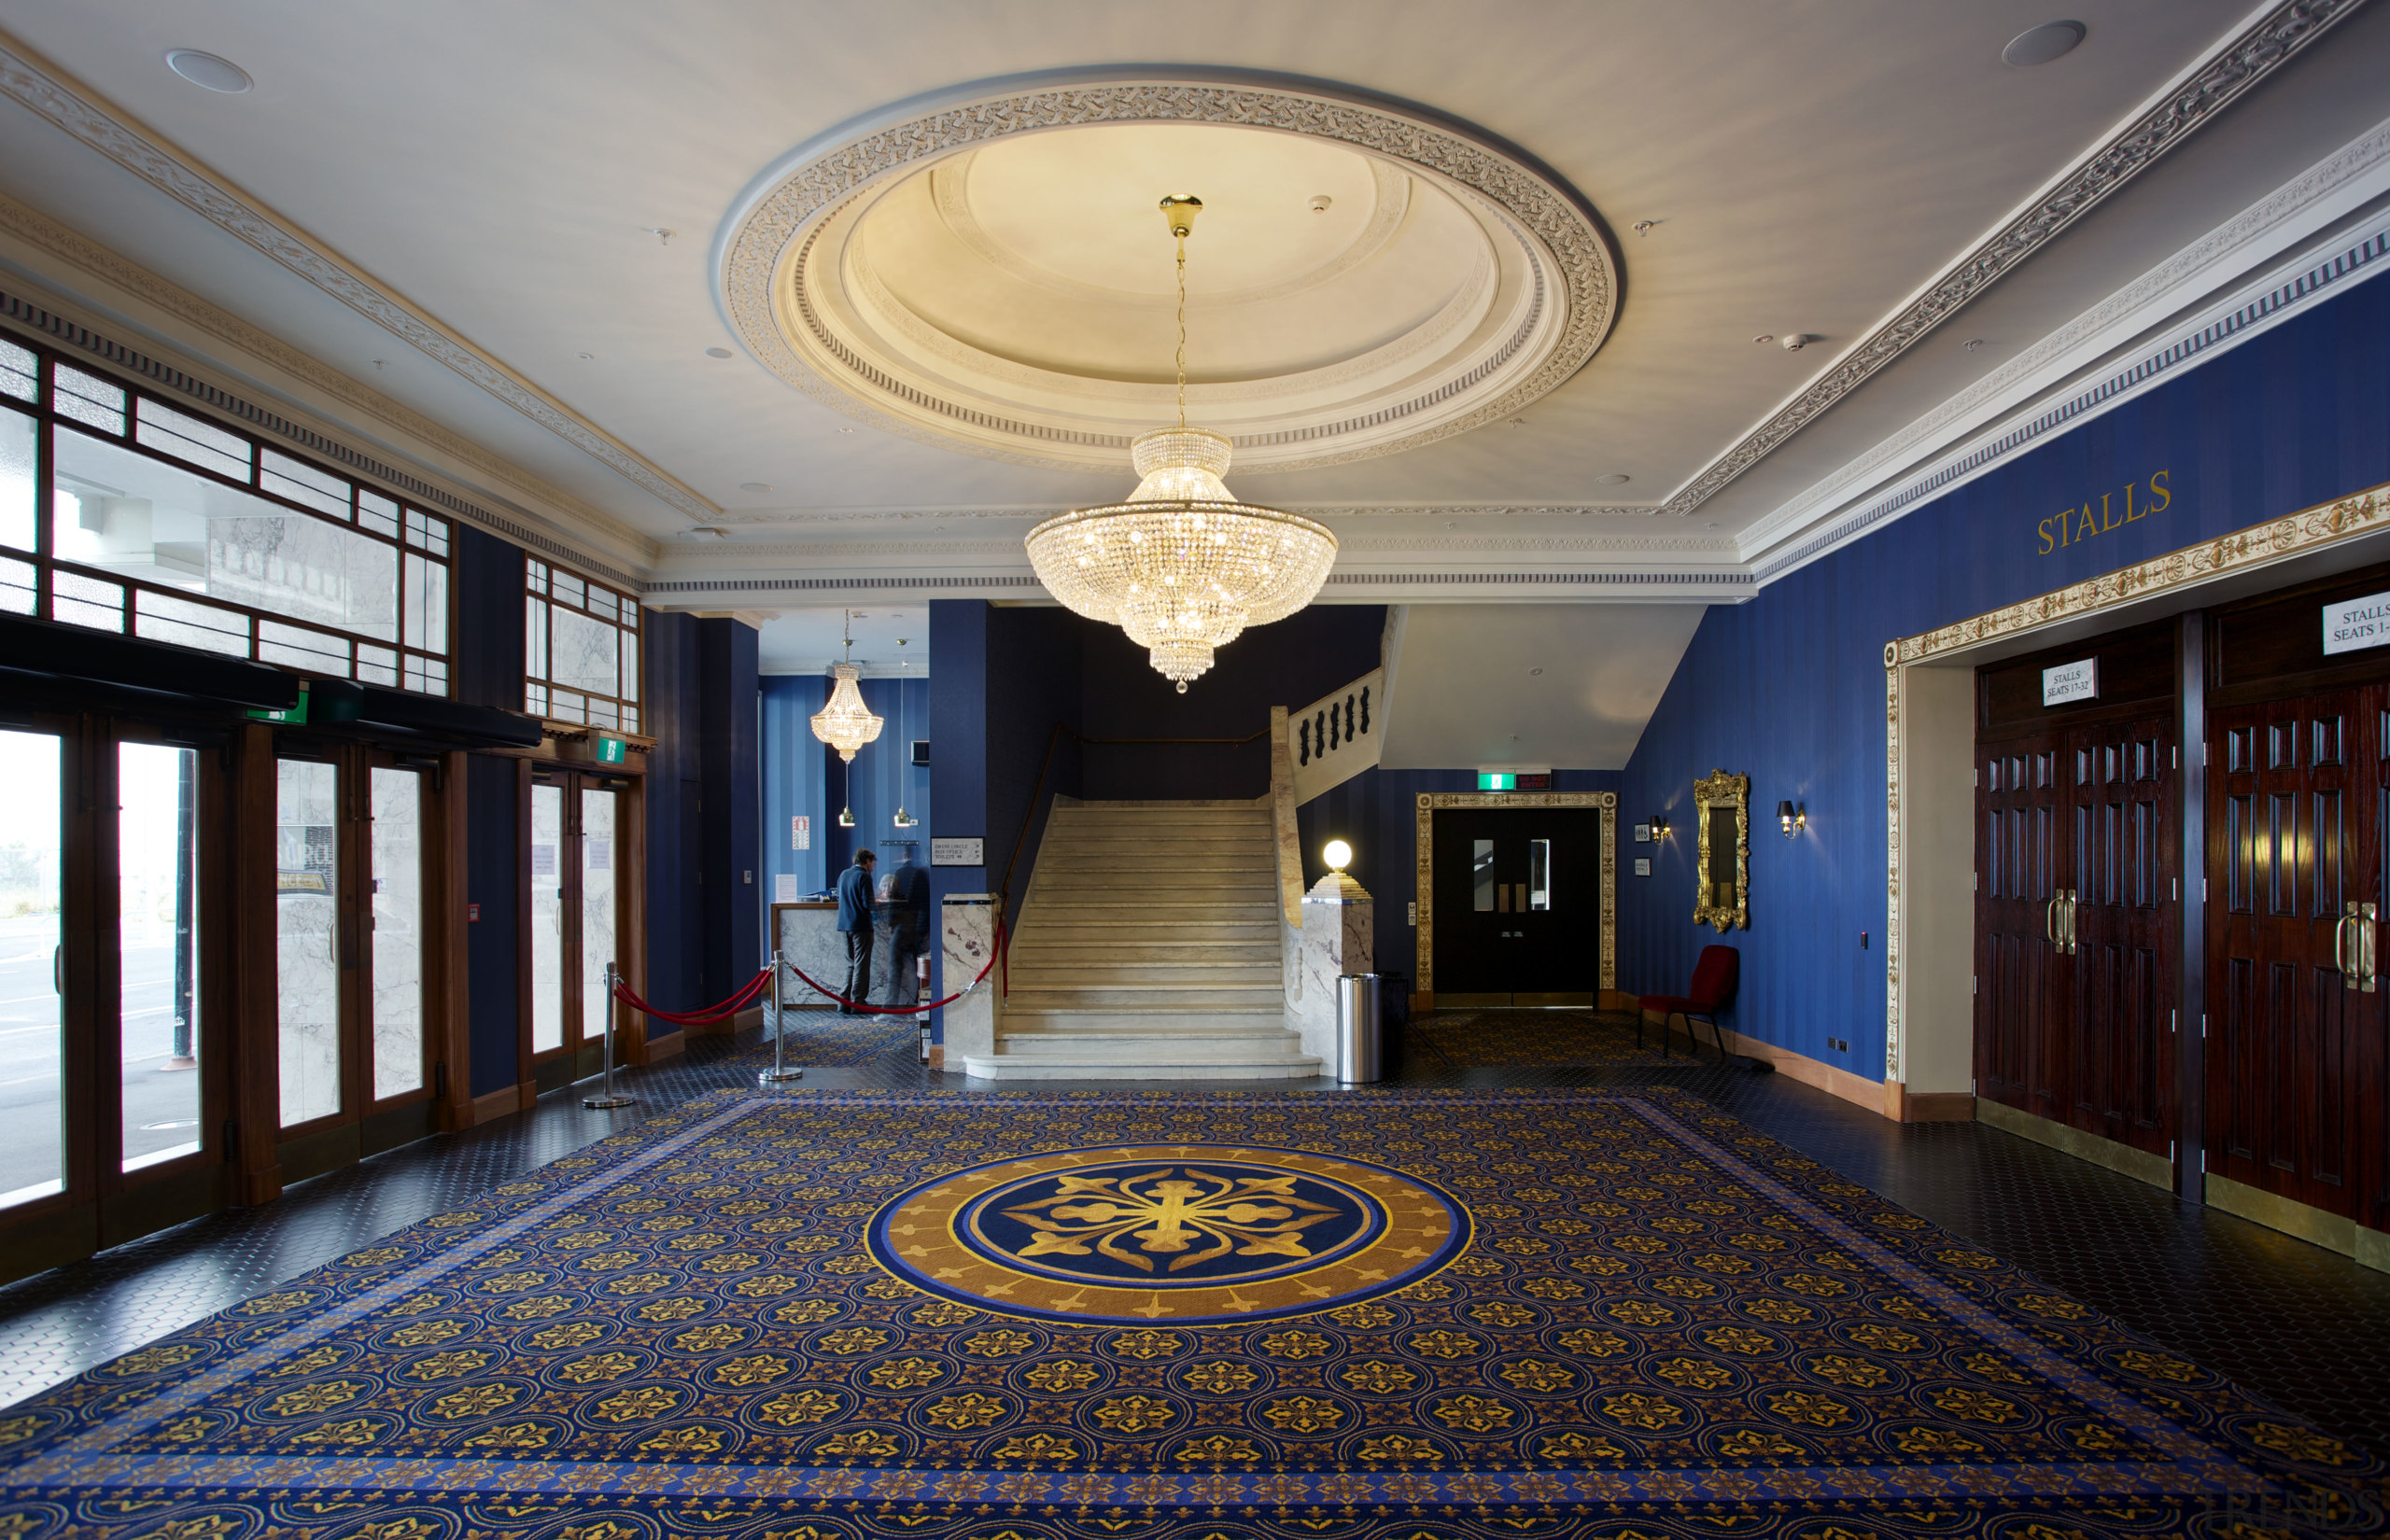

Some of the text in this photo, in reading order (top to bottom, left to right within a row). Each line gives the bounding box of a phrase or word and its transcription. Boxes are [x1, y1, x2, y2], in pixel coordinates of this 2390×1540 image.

[2038, 469, 2172, 556] STALLS
[2334, 623, 2374, 642] SEATS
[2054, 670, 2081, 684] STALLS
[2047, 685, 2070, 697] SEATS
